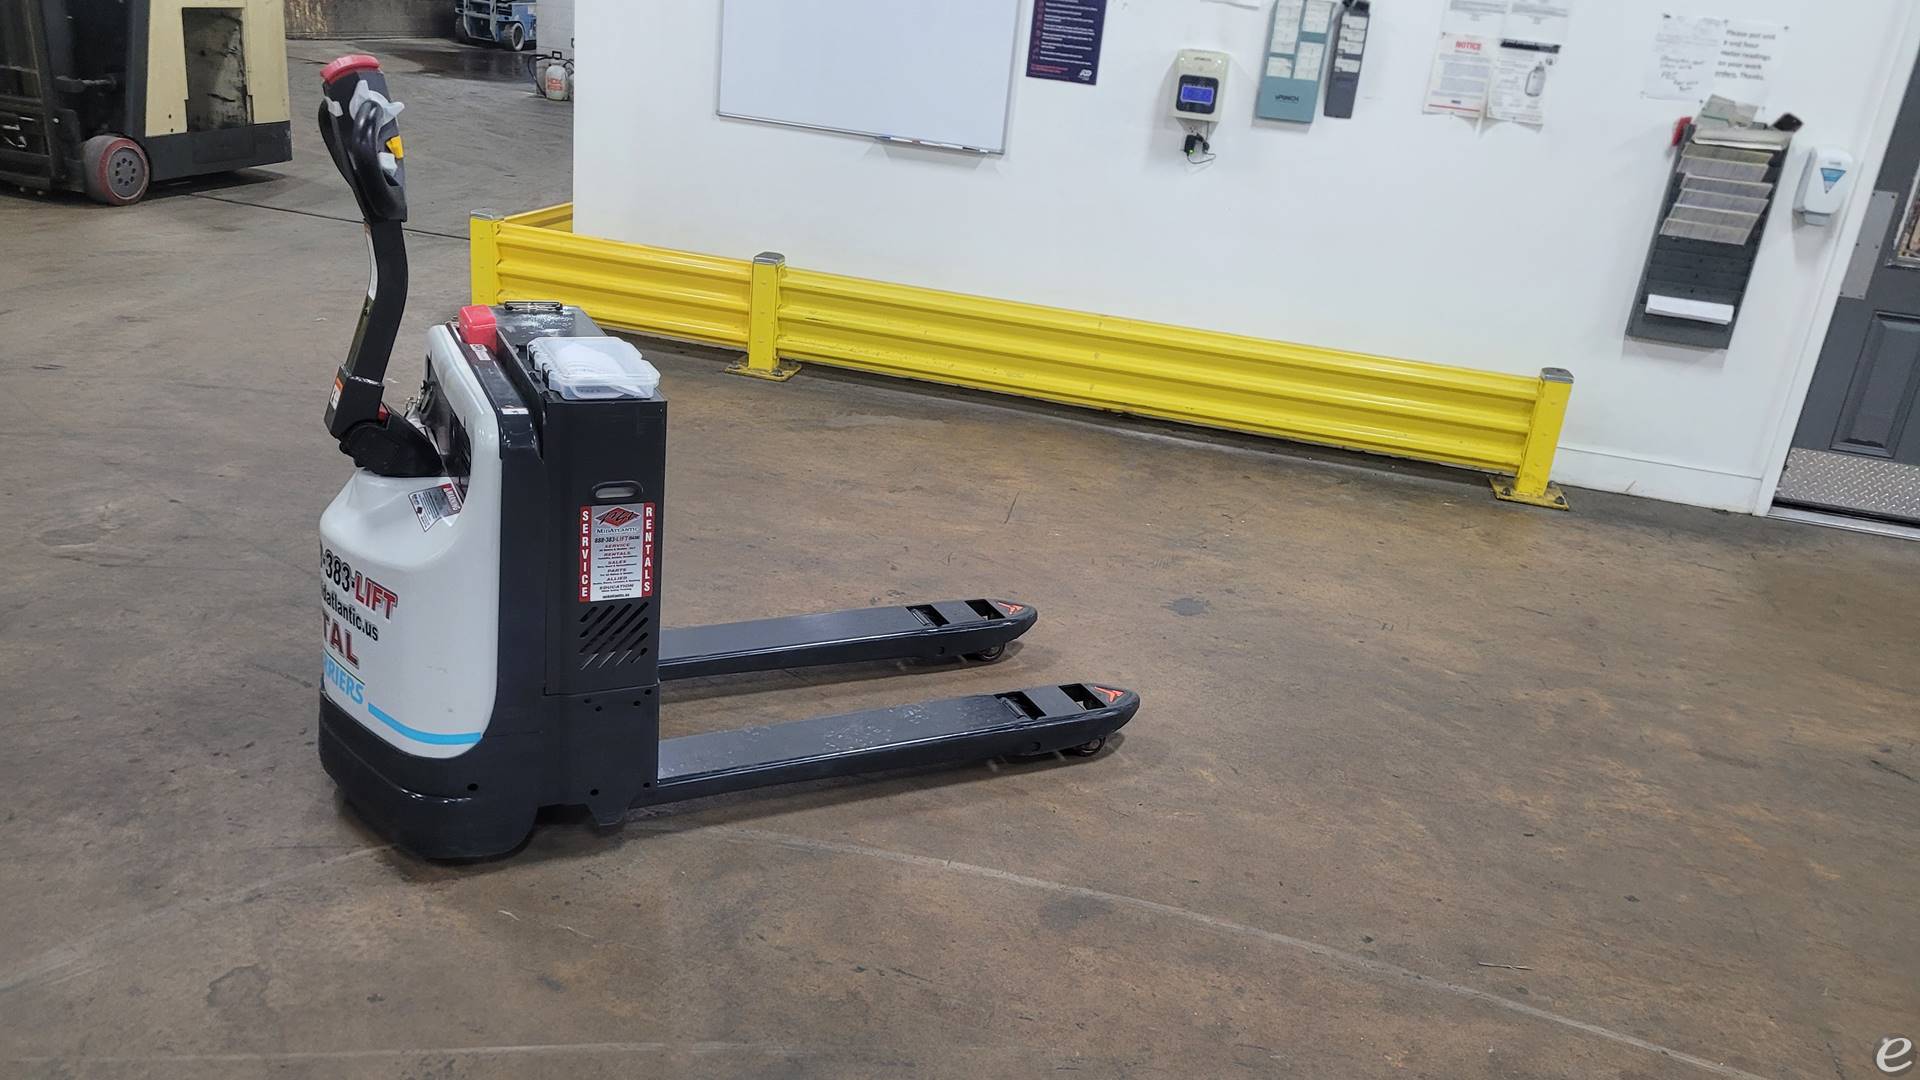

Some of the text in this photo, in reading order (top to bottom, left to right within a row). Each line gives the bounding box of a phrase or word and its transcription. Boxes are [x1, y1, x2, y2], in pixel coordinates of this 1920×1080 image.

[1455, 40, 1482, 51] NOTICE
[320, 540, 399, 622] -383-LIFT
[582, 511, 590, 597] SERVICE
[644, 507, 653, 591] RENTALS
[321, 583, 379, 642] datlantic.us
